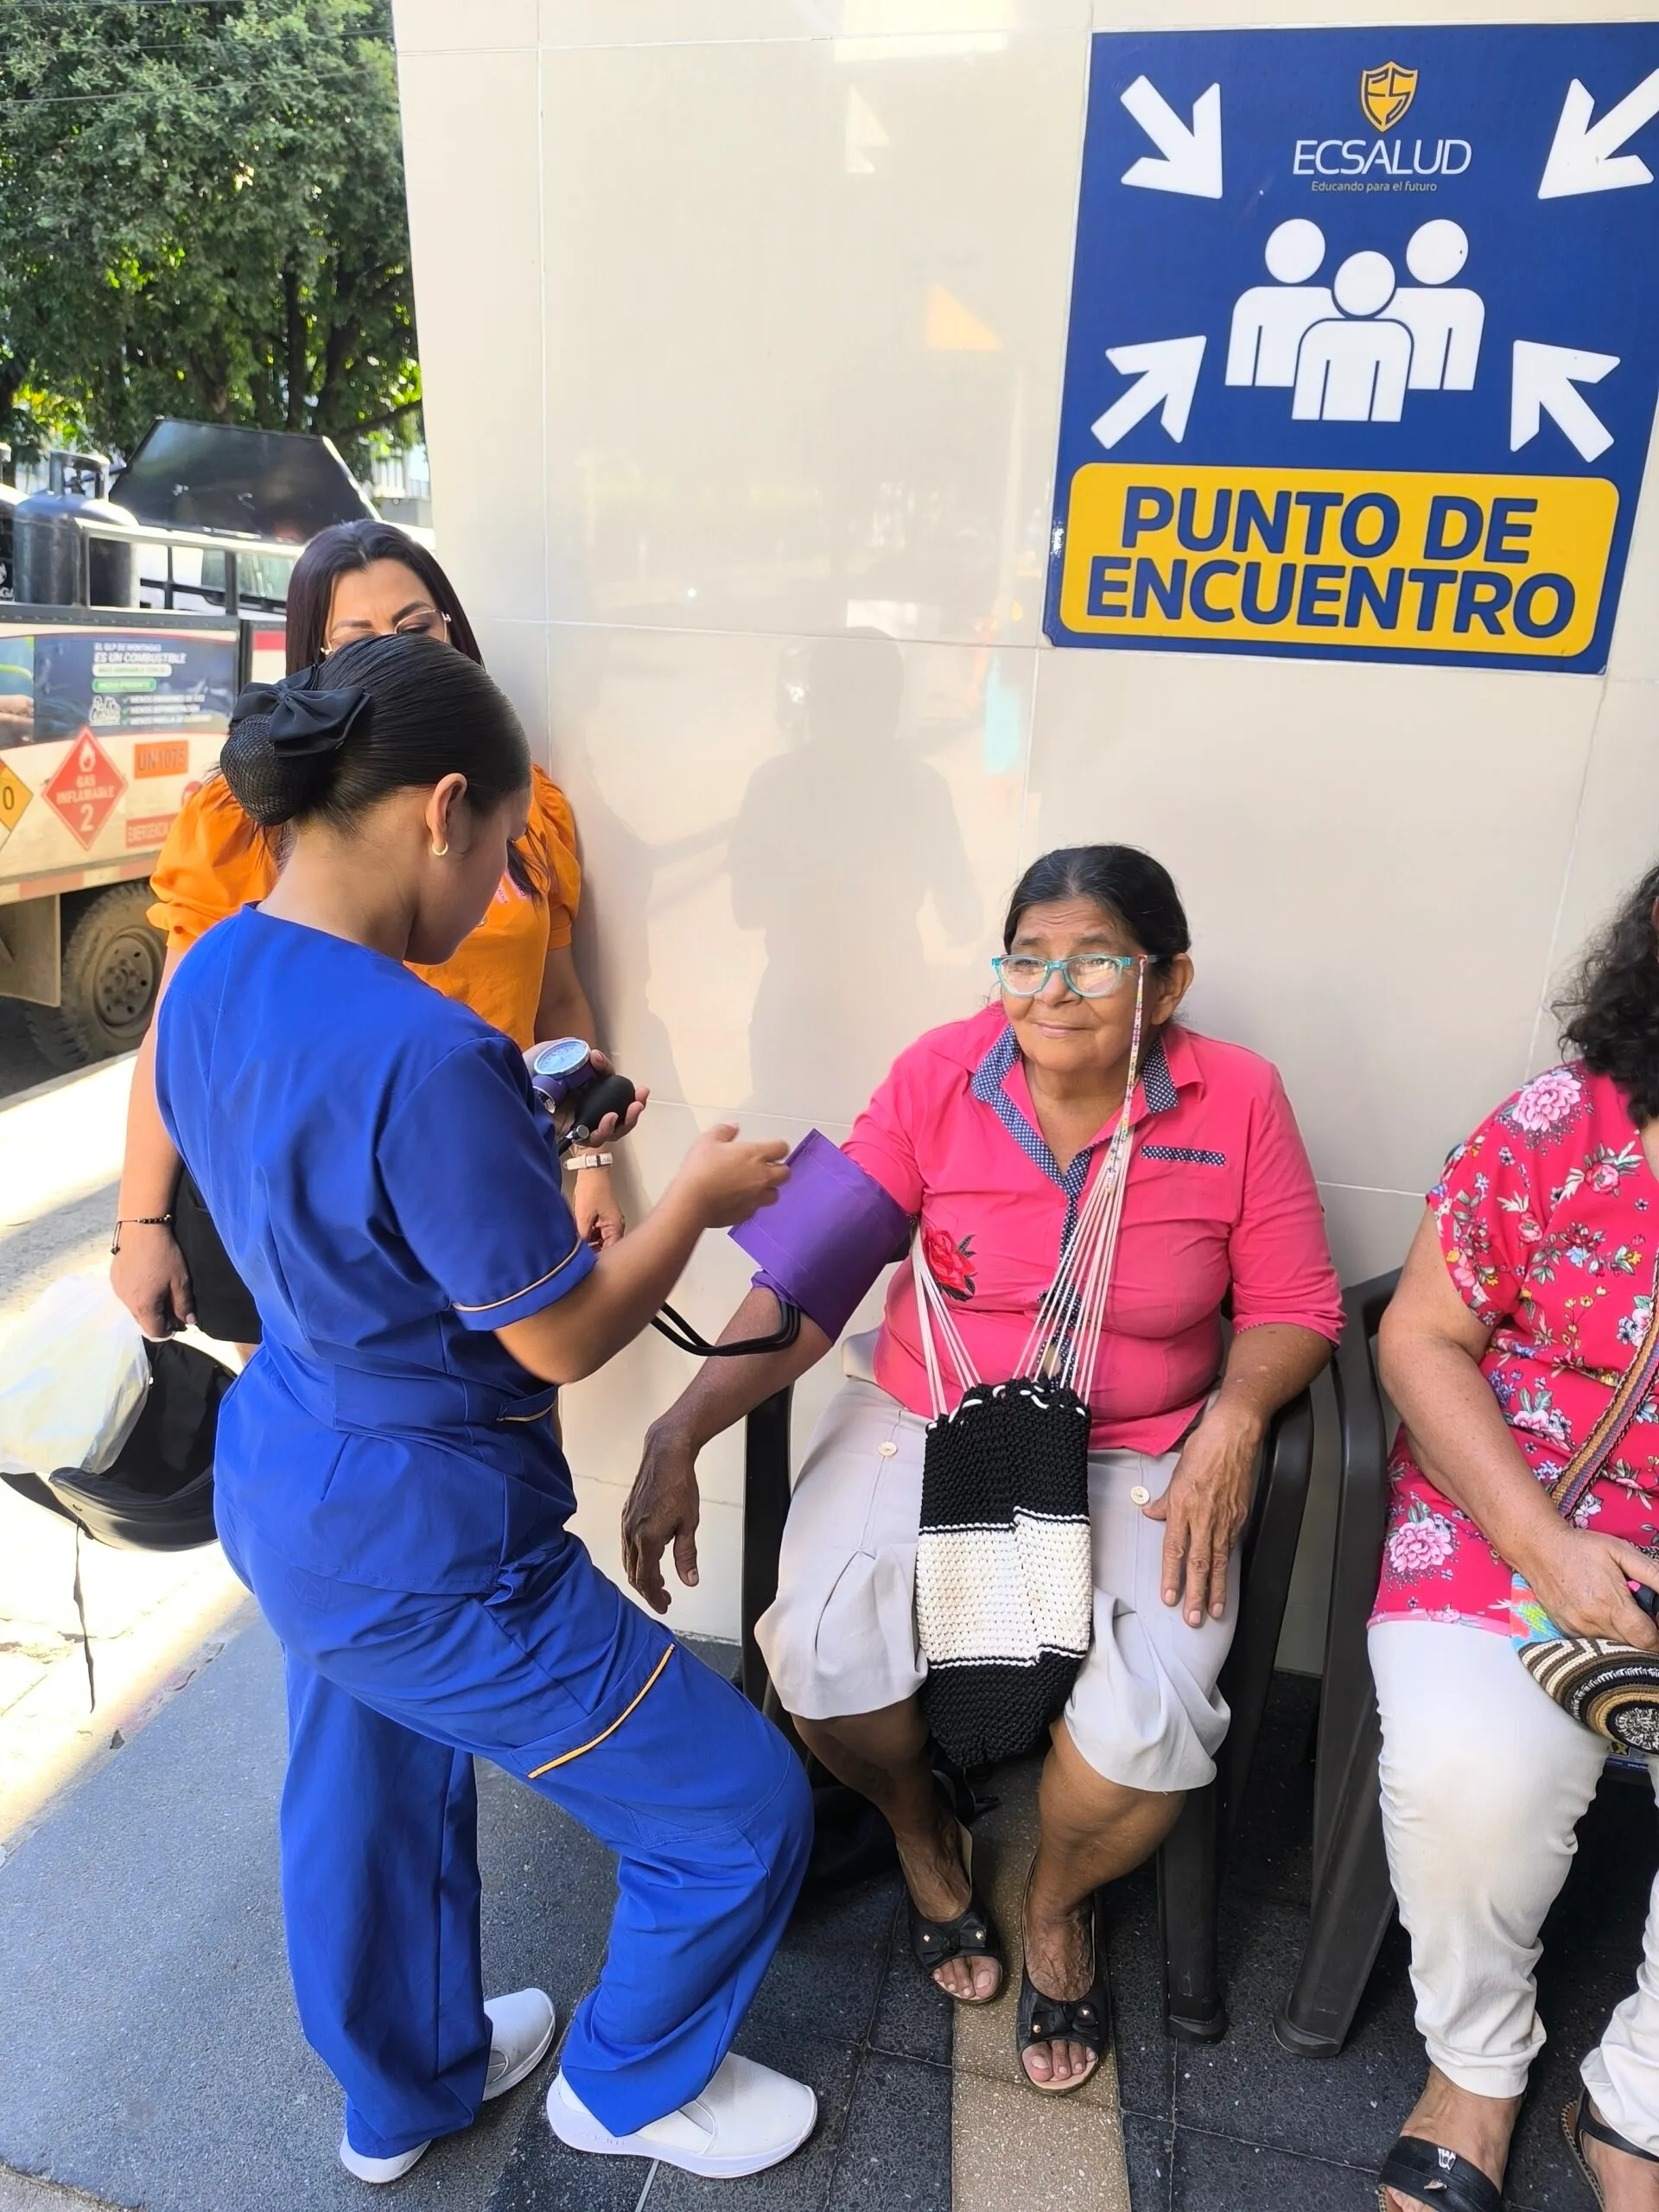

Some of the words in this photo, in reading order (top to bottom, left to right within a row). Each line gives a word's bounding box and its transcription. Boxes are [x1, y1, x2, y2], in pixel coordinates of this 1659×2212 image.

[1293, 139, 1472, 175] ECSALUD
[1311, 180, 1364, 192] Educando
[1366, 182, 1390, 194] para
[1392, 181, 1403, 192] el
[1404, 180, 1438, 192] futuro
[1122, 486, 1400, 558] PUNTO
[1423, 495, 1538, 563] DE
[1086, 557, 1576, 638] ENCUENTRO
[94, 652, 108, 664] ES
[108, 652, 123, 664] UN
[123, 652, 187, 664] COMBUSTIBLE
[137, 747, 186, 772] UN1075
[76, 774, 96, 788] GAS
[56, 785, 117, 805] INFLAMABLE
[80, 803, 94, 832] 2
